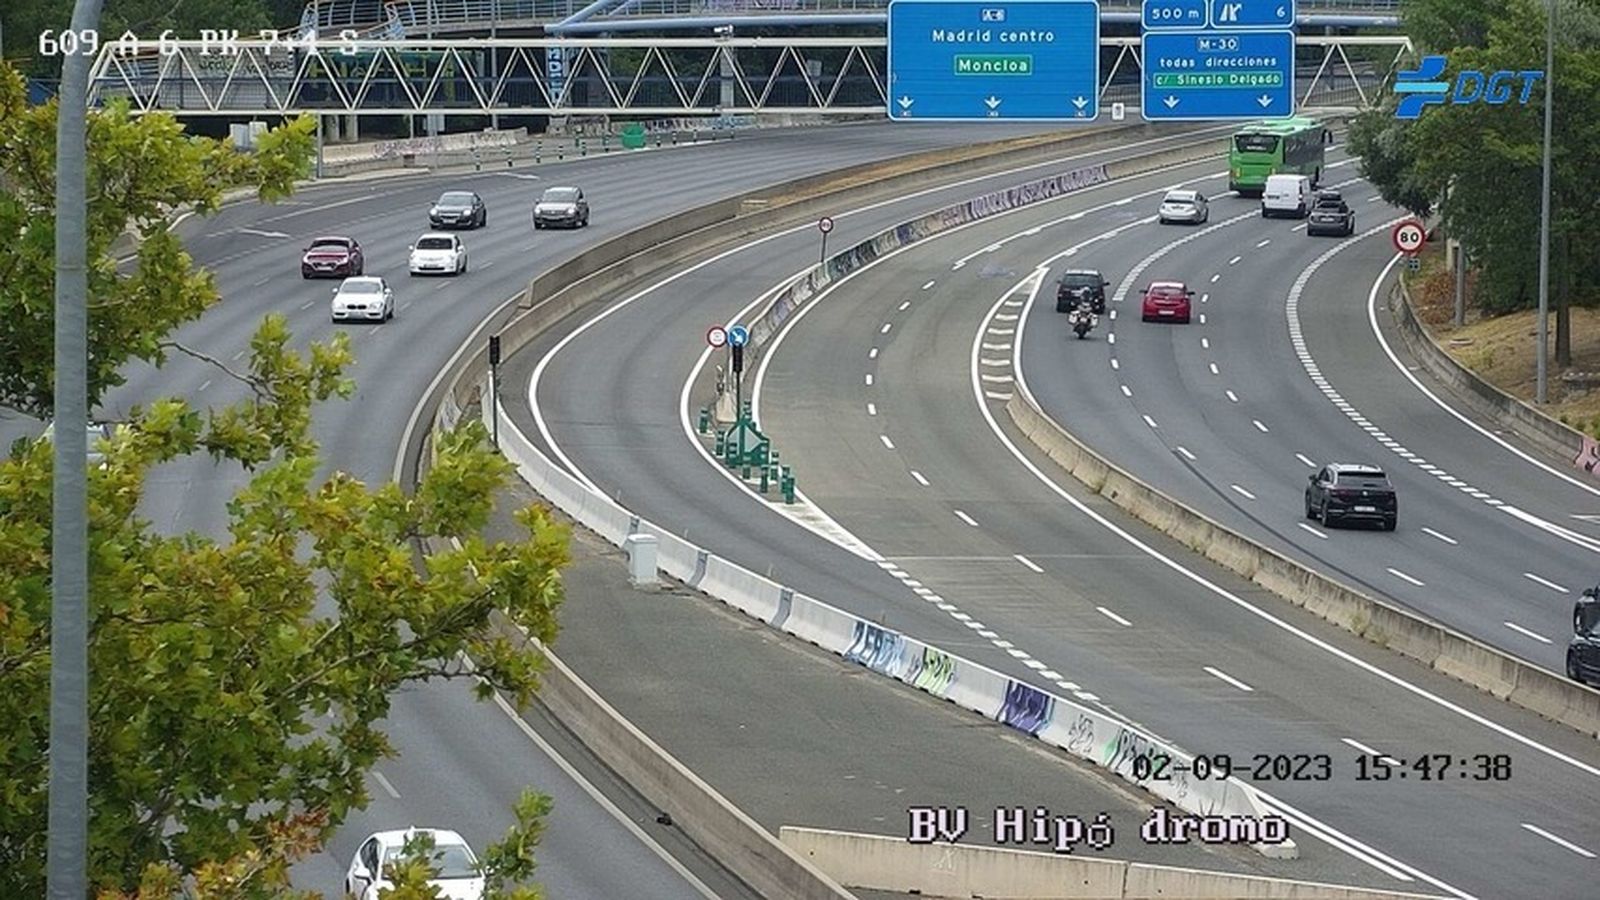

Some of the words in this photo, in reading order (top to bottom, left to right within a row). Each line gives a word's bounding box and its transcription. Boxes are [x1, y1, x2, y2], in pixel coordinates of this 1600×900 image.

[1152, 8, 1182, 19] 500
[1188, 9, 1200, 18] m
[1276, 6, 1286, 18] 6
[932, 29, 991, 42] Madrid
[1000, 30, 1054, 42] centro
[1199, 38, 1238, 50] M-30
[958, 59, 1028, 72] Moncloa
[1160, 57, 1195, 68] todas
[1205, 56, 1277, 67] direcciones
[1156, 74, 1169, 85] c/
[1177, 73, 1224, 85] Sinesio
[1230, 73, 1281, 86] Delgado
[1400, 232, 1420, 243] 80
